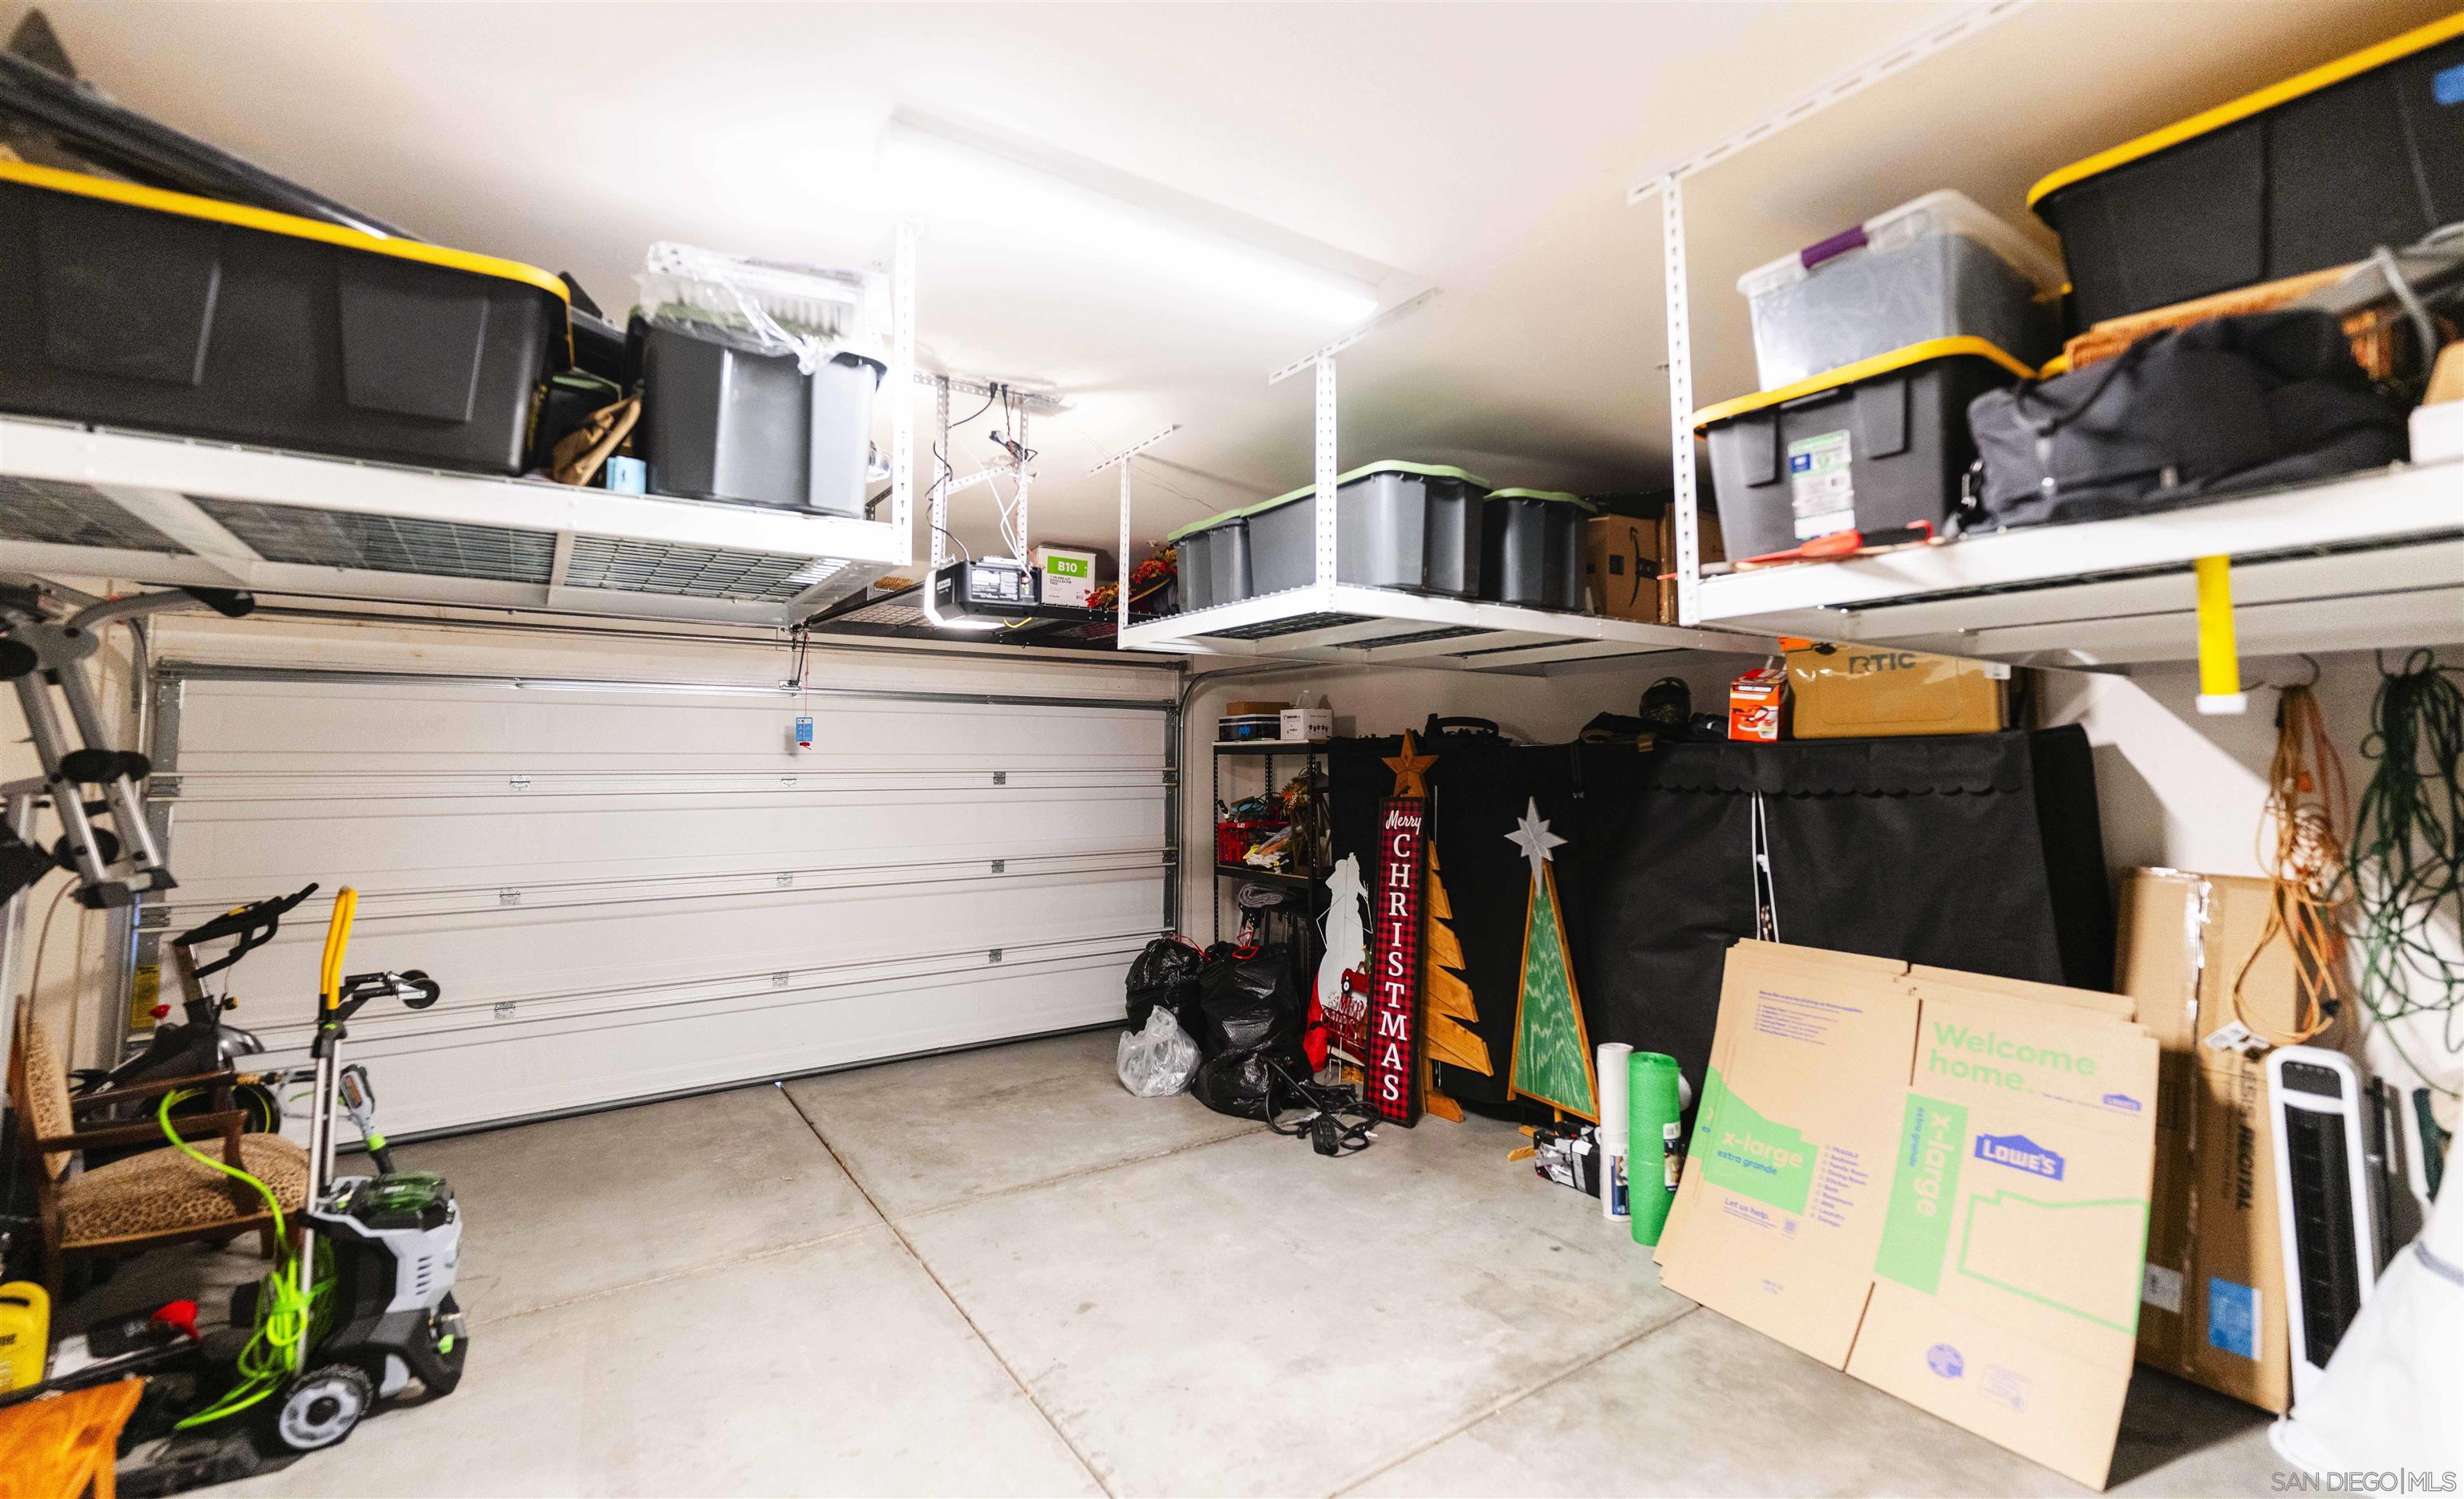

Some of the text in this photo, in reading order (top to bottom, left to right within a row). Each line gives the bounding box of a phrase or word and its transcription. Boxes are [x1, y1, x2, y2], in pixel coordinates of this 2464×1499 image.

[1058, 561, 1078, 573] B10
[1848, 653, 1917, 675] RTIC
[1385, 809, 1421, 835] Merry
[1378, 833, 1411, 1101] CHRISTMAS
[1933, 1020, 2097, 1077] Welcome
[1928, 1048, 2035, 1094] home.
[1717, 1150, 1777, 1175] extra grande
[1722, 1131, 1803, 1169] x-large
[1914, 1112, 1955, 1217] x-large
[1982, 1138, 2057, 1177] LOWE'S
